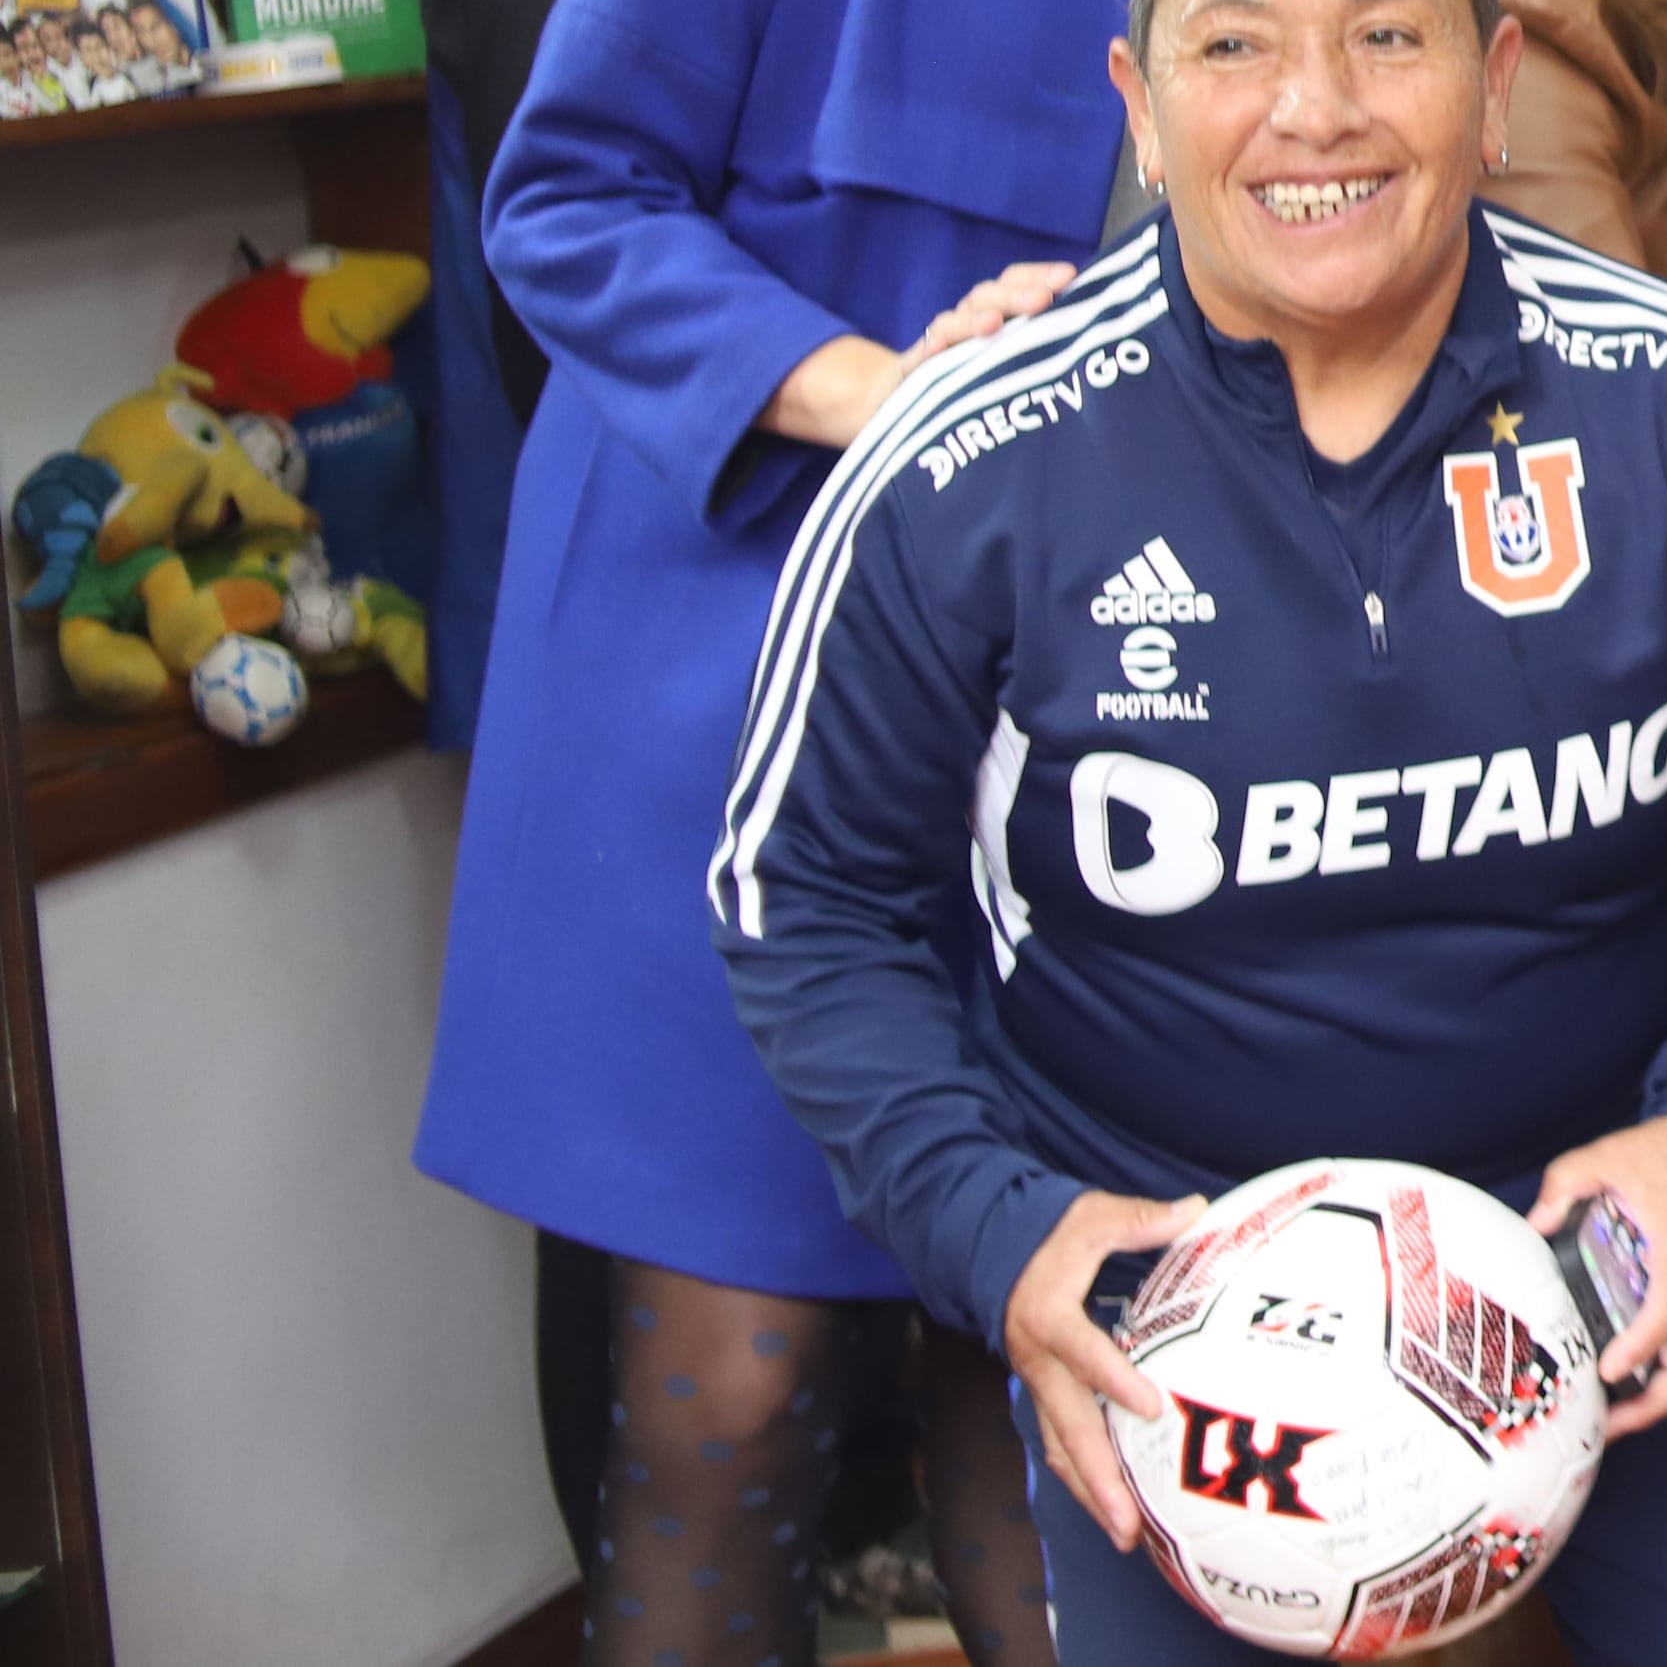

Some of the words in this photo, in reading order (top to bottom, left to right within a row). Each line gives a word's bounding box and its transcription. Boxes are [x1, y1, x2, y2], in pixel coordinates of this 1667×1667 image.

[917, 369, 1084, 493] DIRECTV
[1085, 338, 1150, 389] GO
[1090, 588, 1216, 625] adidas
[1200, 1566, 1320, 1609] CRUZA
